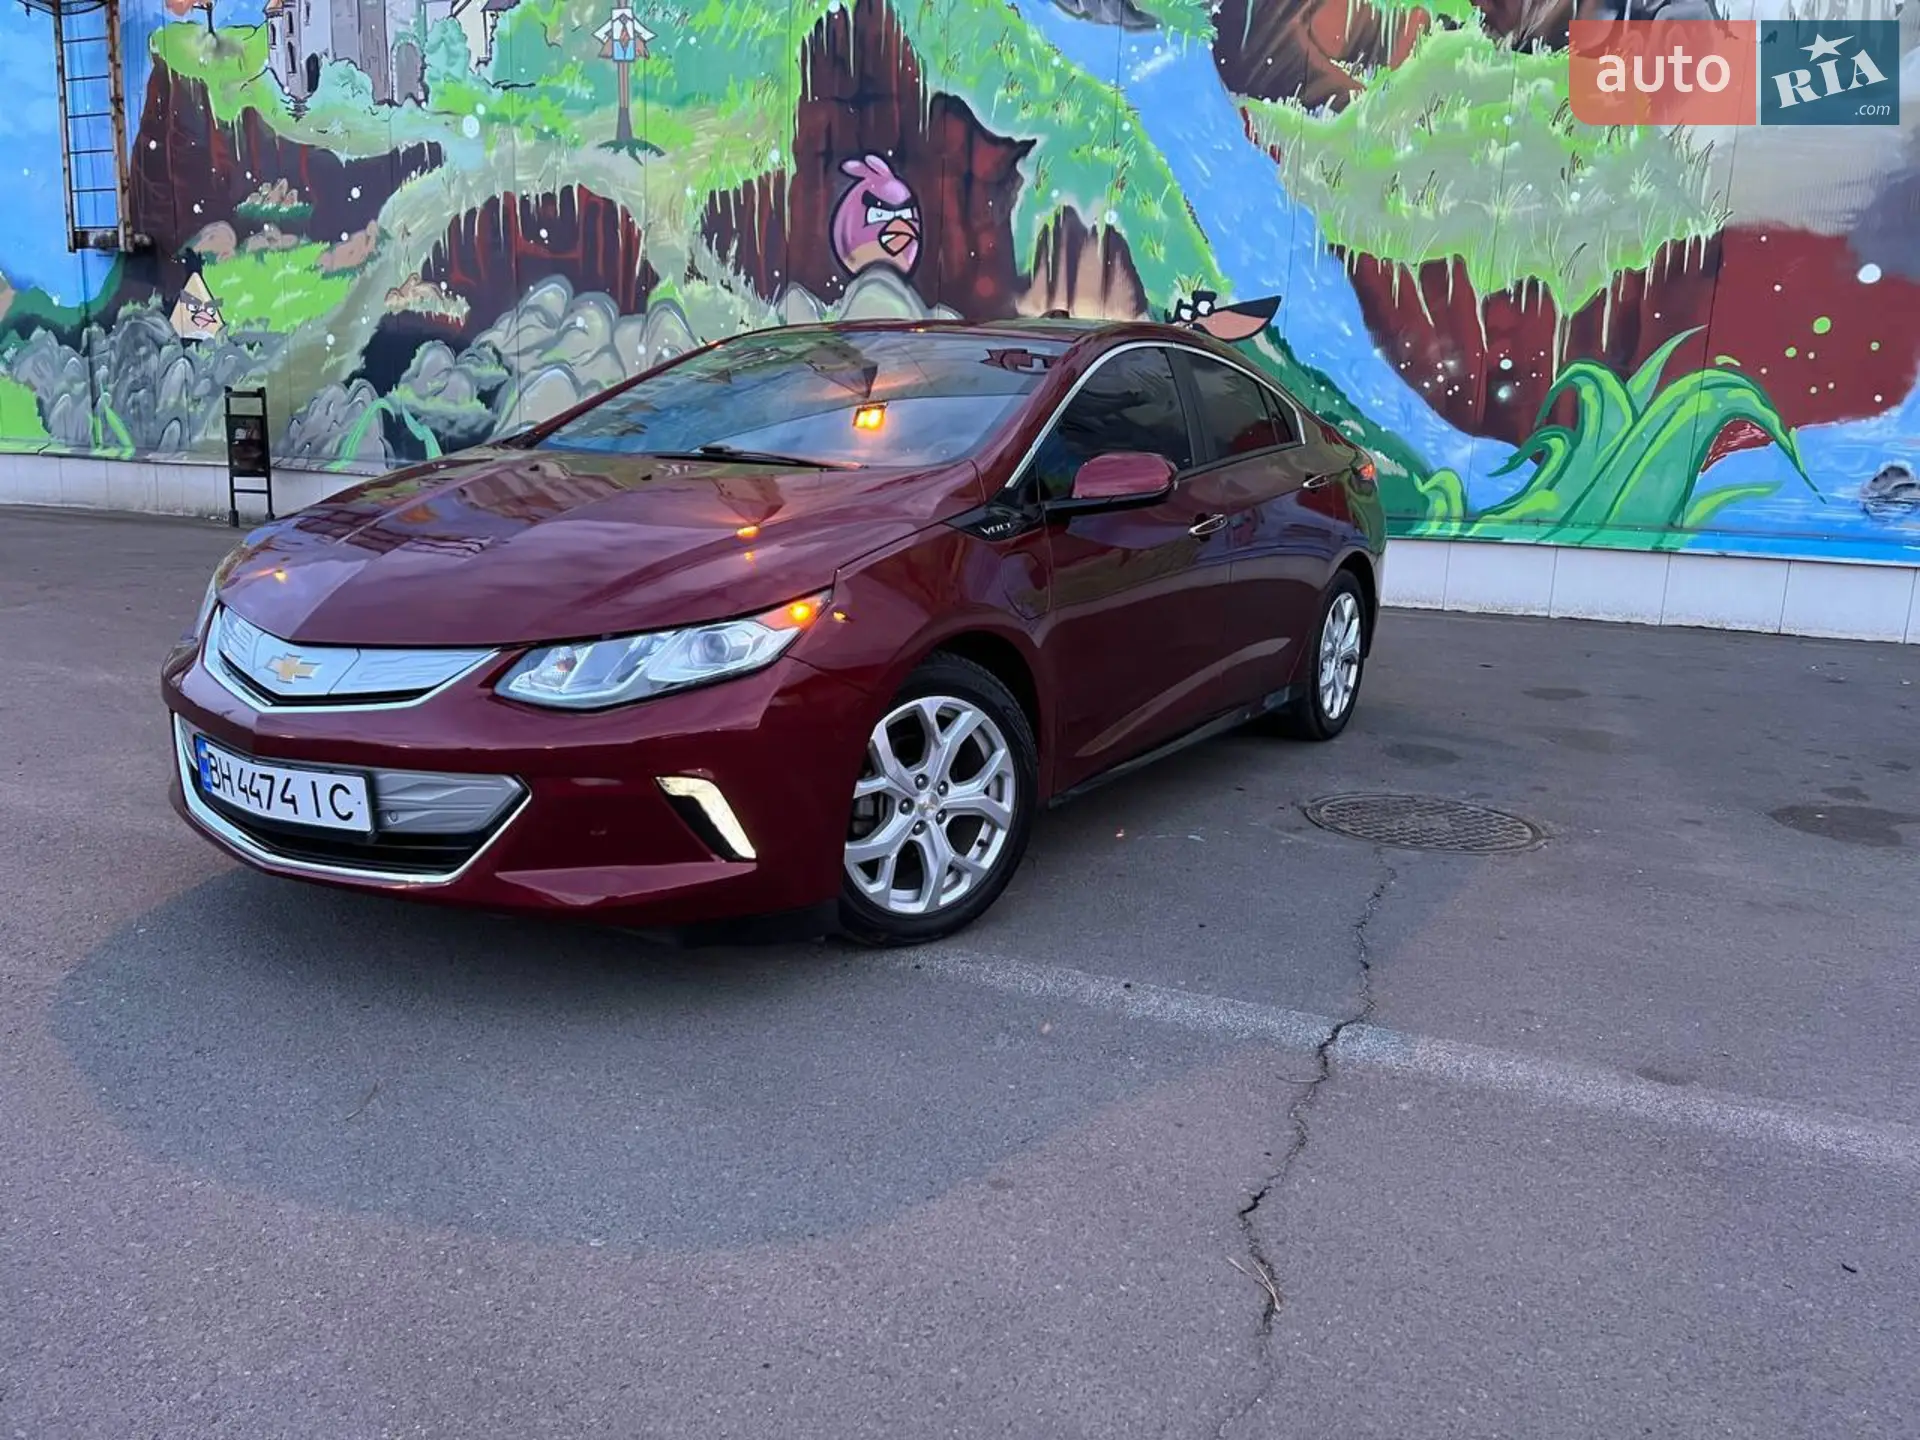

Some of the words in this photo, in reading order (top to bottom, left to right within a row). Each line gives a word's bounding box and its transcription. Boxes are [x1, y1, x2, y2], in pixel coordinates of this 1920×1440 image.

[980, 522, 1011, 535] VOLT
[208, 753, 235, 797] BH
[238, 767, 299, 815] 4474
[310, 780, 354, 821] IC
